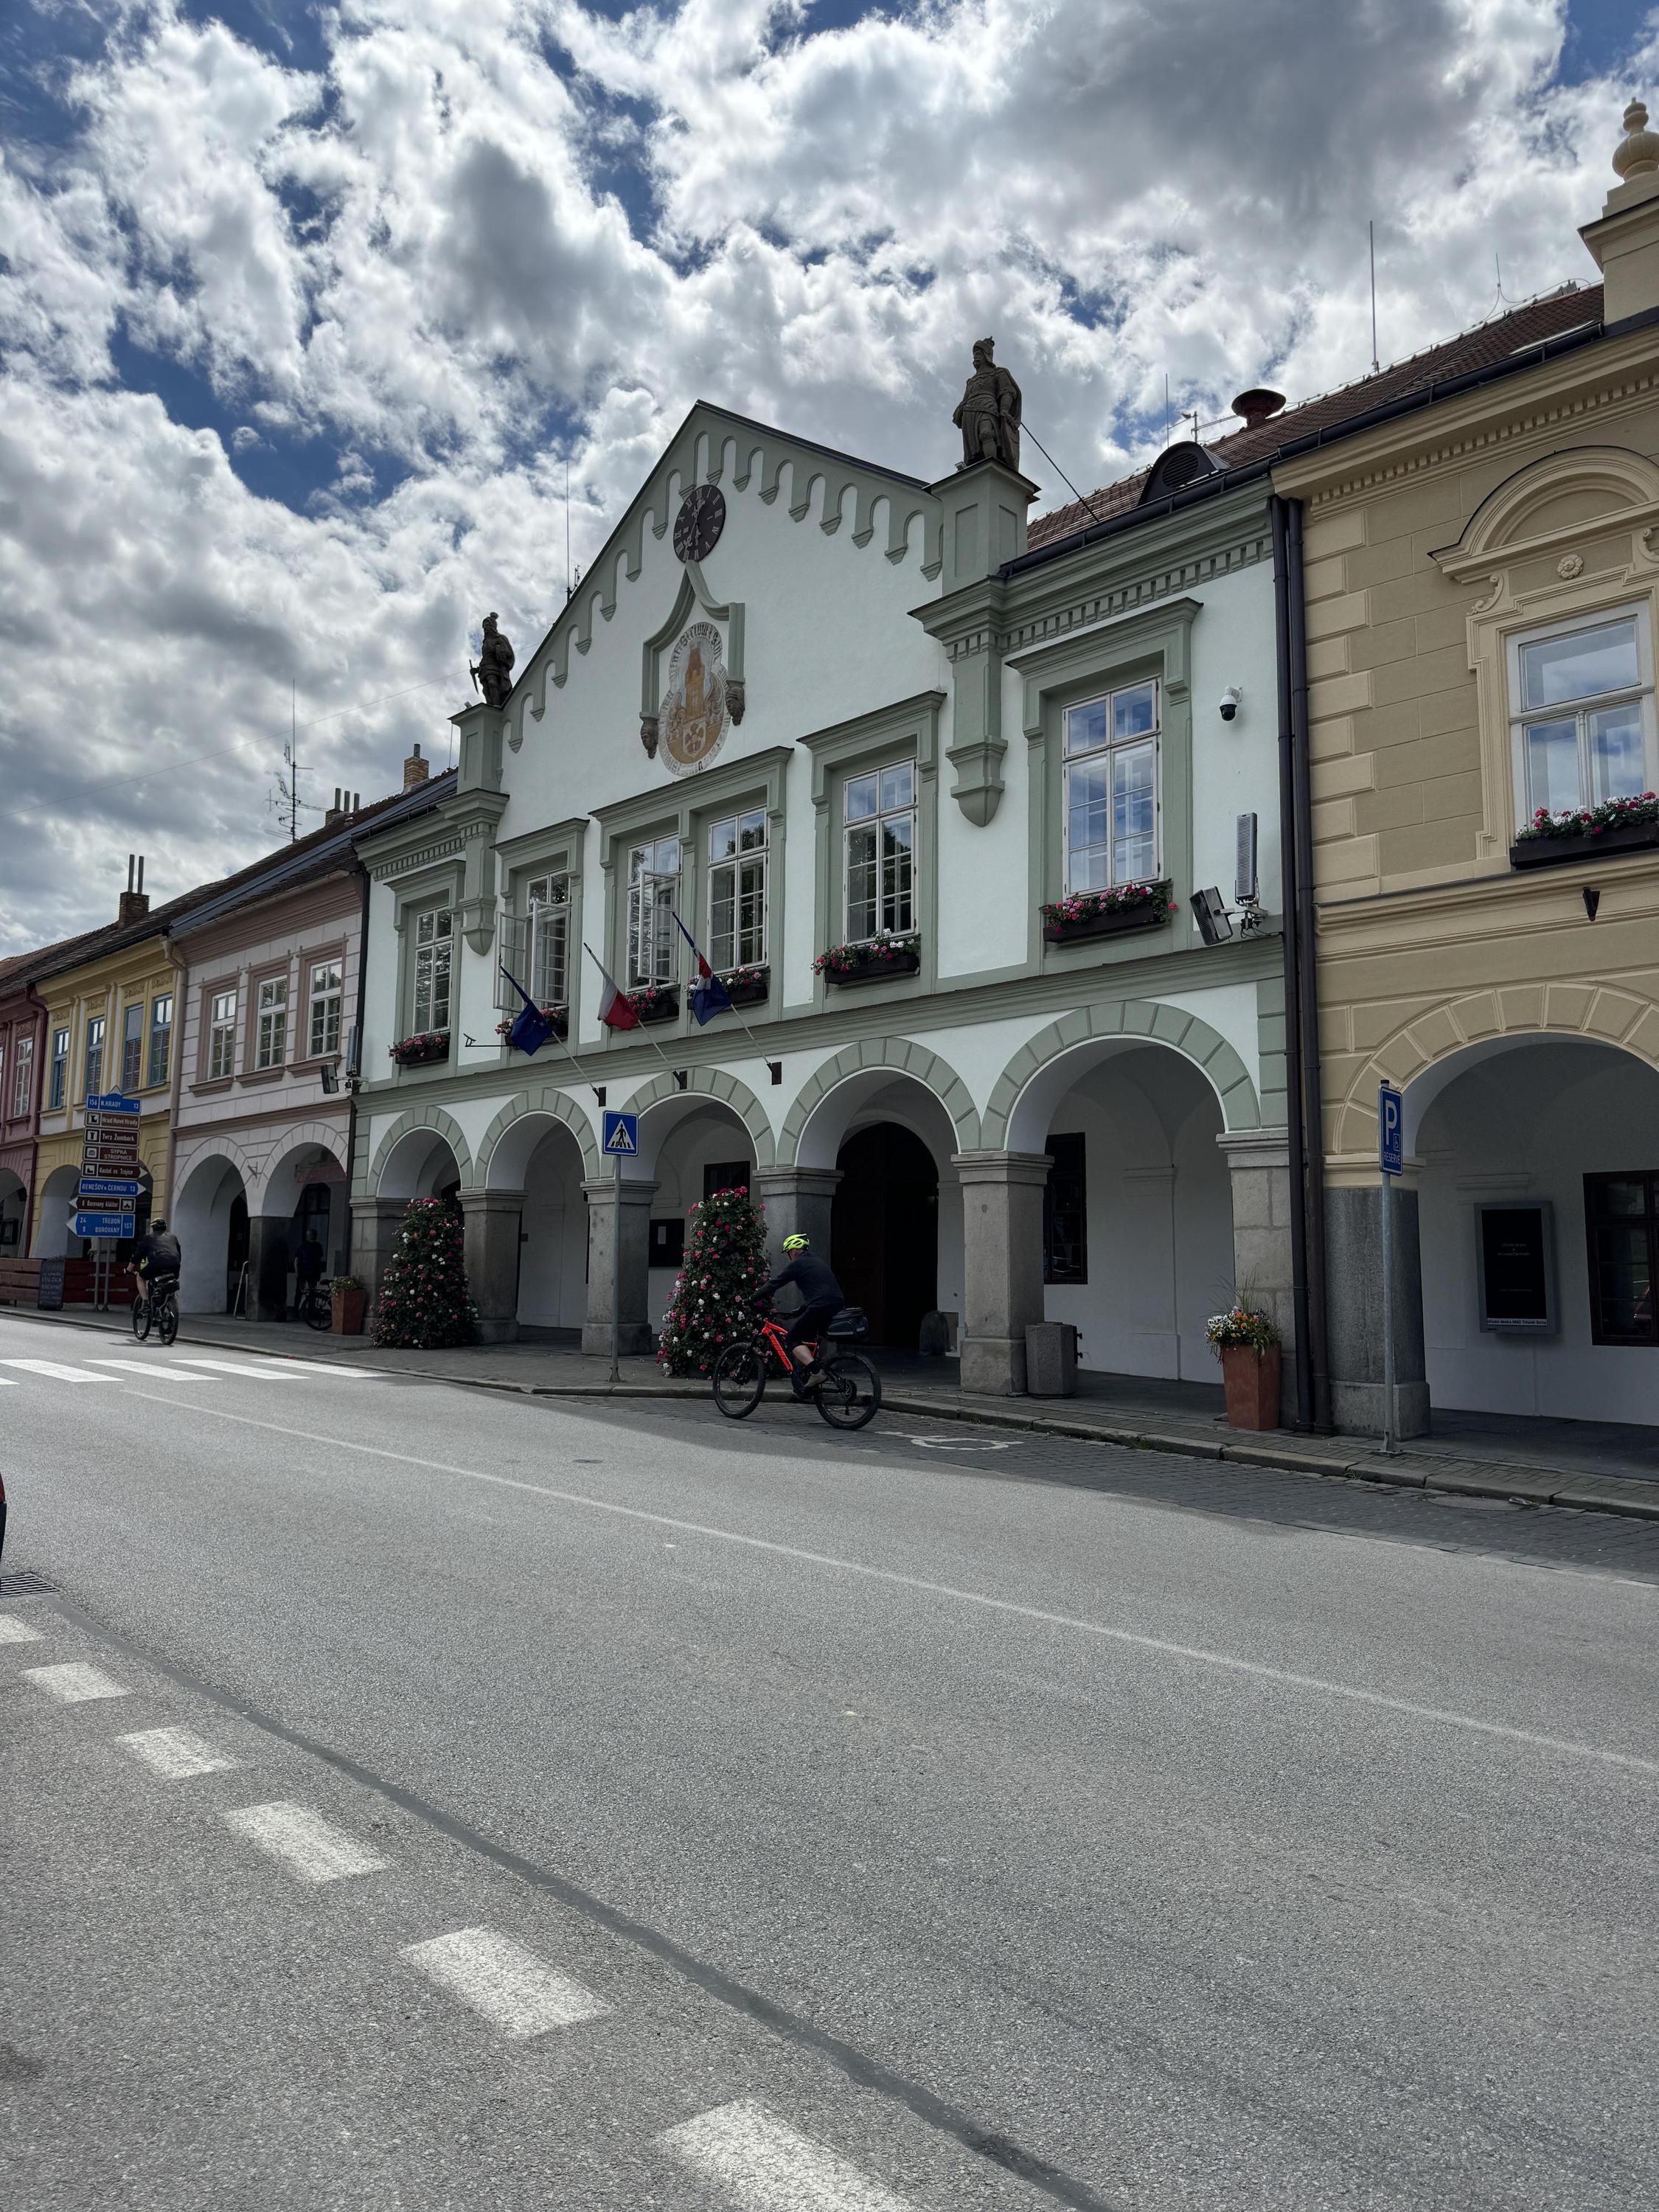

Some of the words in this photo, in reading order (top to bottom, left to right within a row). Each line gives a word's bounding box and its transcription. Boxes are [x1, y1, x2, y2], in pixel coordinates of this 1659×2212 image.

[1385, 1099, 1397, 1145] P
[102, 1133, 113, 1141] Tvrz
[82, 1183, 104, 1191] BENEŠOV
